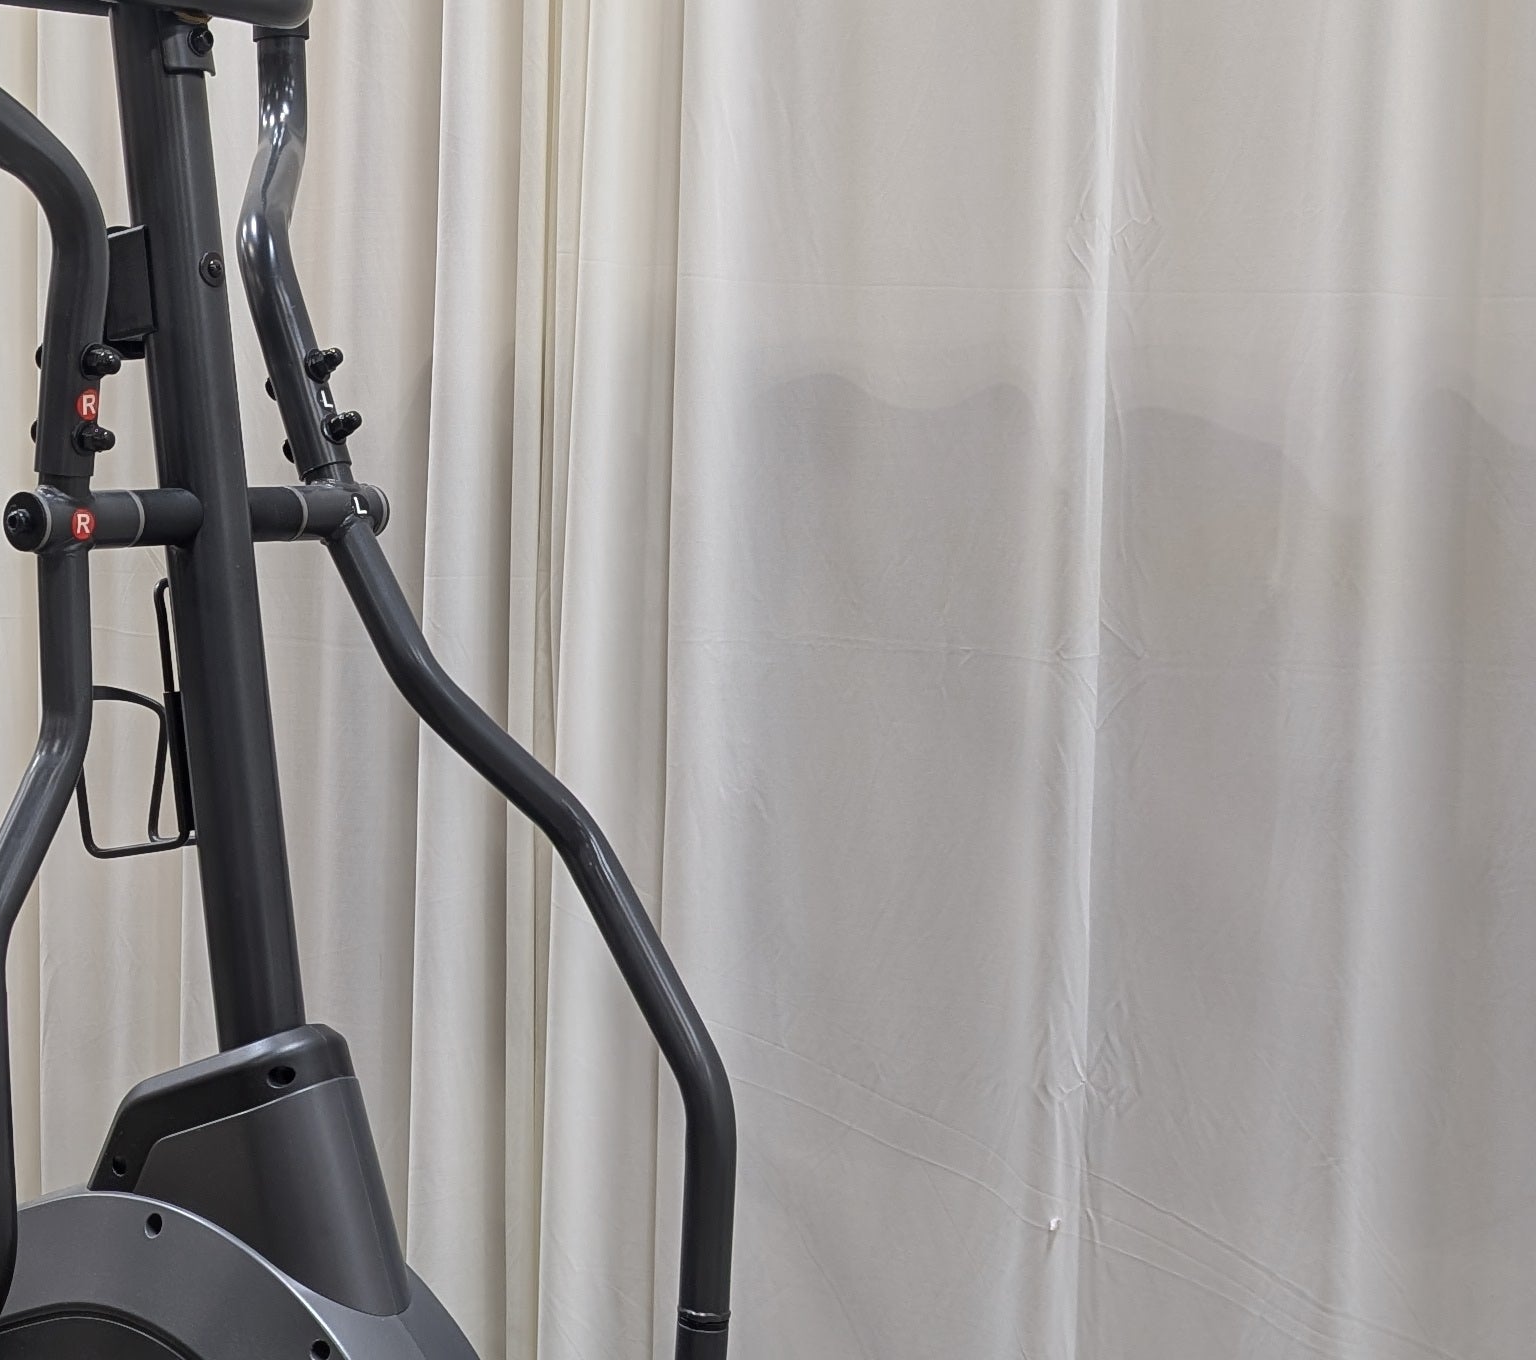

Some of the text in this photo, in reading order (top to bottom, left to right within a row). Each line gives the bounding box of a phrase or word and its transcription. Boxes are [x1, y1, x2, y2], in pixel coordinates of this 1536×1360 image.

[82, 394, 97, 416] R
[320, 390, 334, 408] L
[353, 496, 368, 515] L
[76, 513, 91, 534] R
